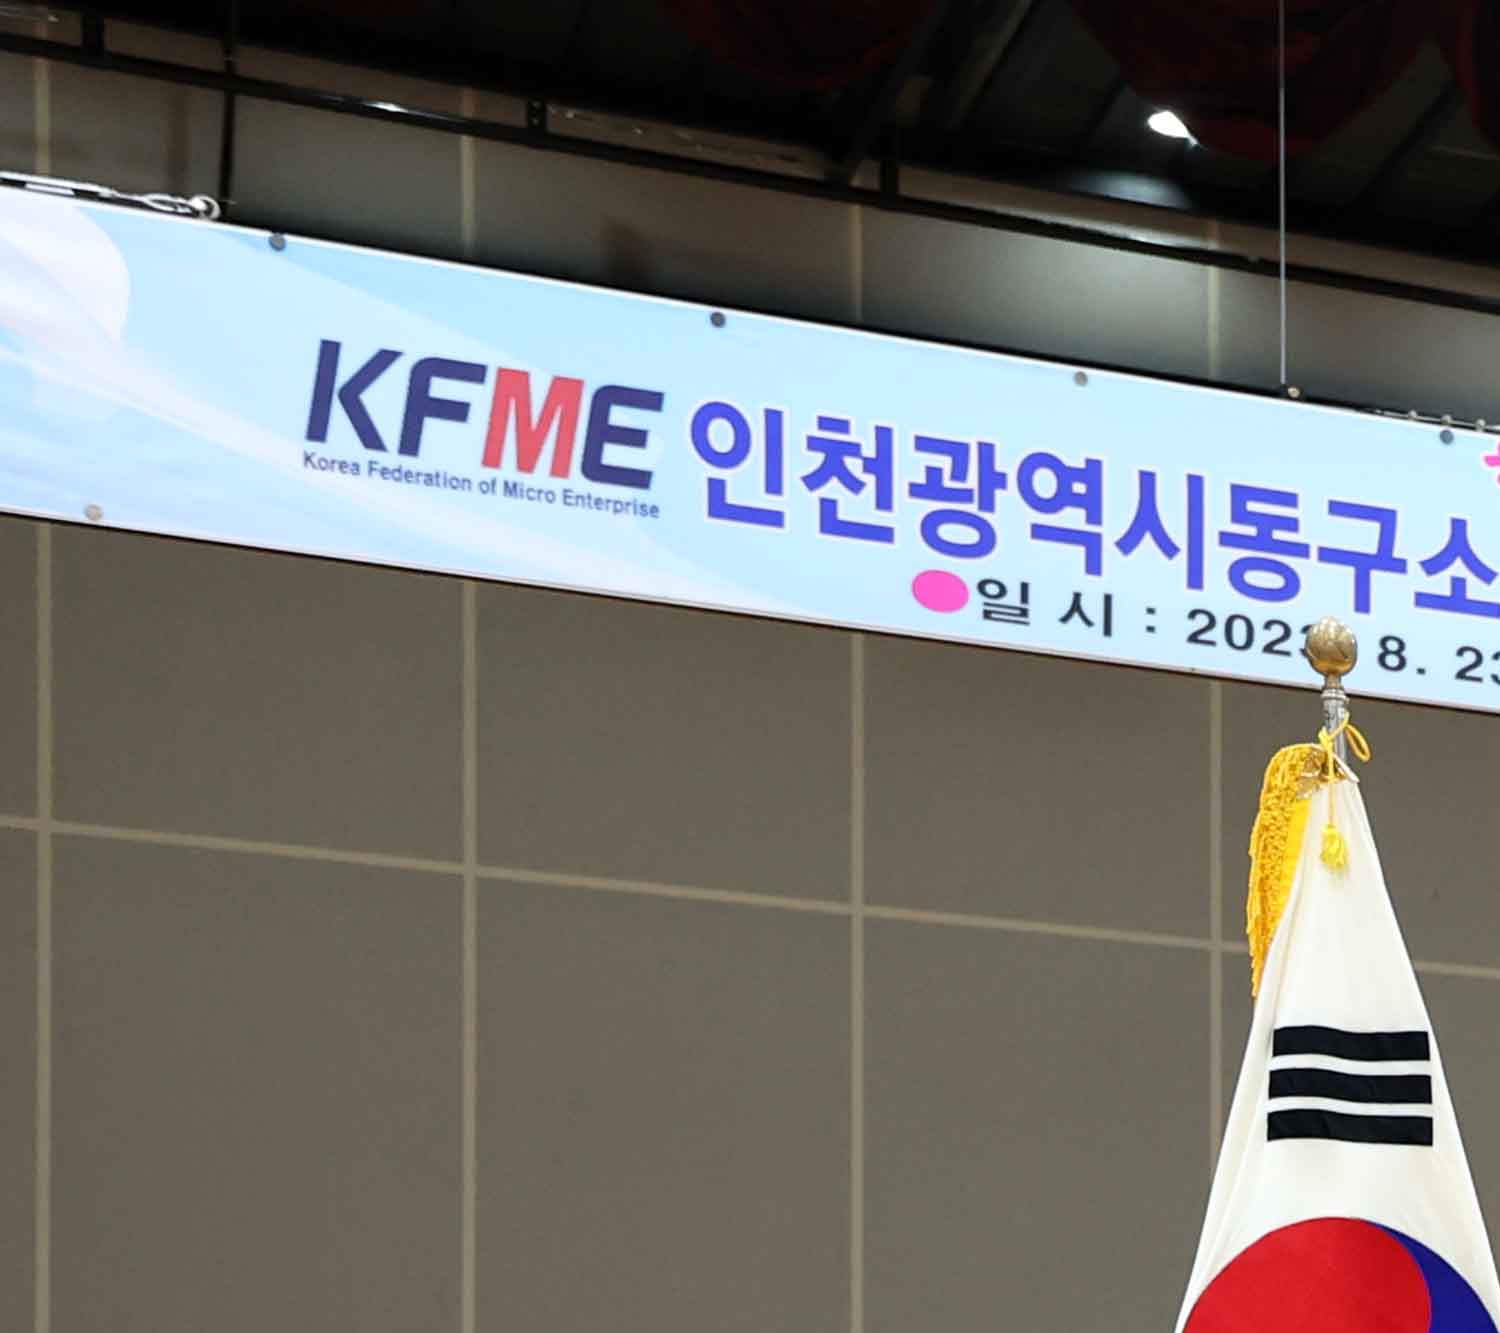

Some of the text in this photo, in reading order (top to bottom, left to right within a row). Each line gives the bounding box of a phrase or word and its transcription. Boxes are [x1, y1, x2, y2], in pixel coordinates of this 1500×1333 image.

[305, 338, 664, 490] KFME
[303, 451, 660, 518] Korea Federation of Micro Enterprise
